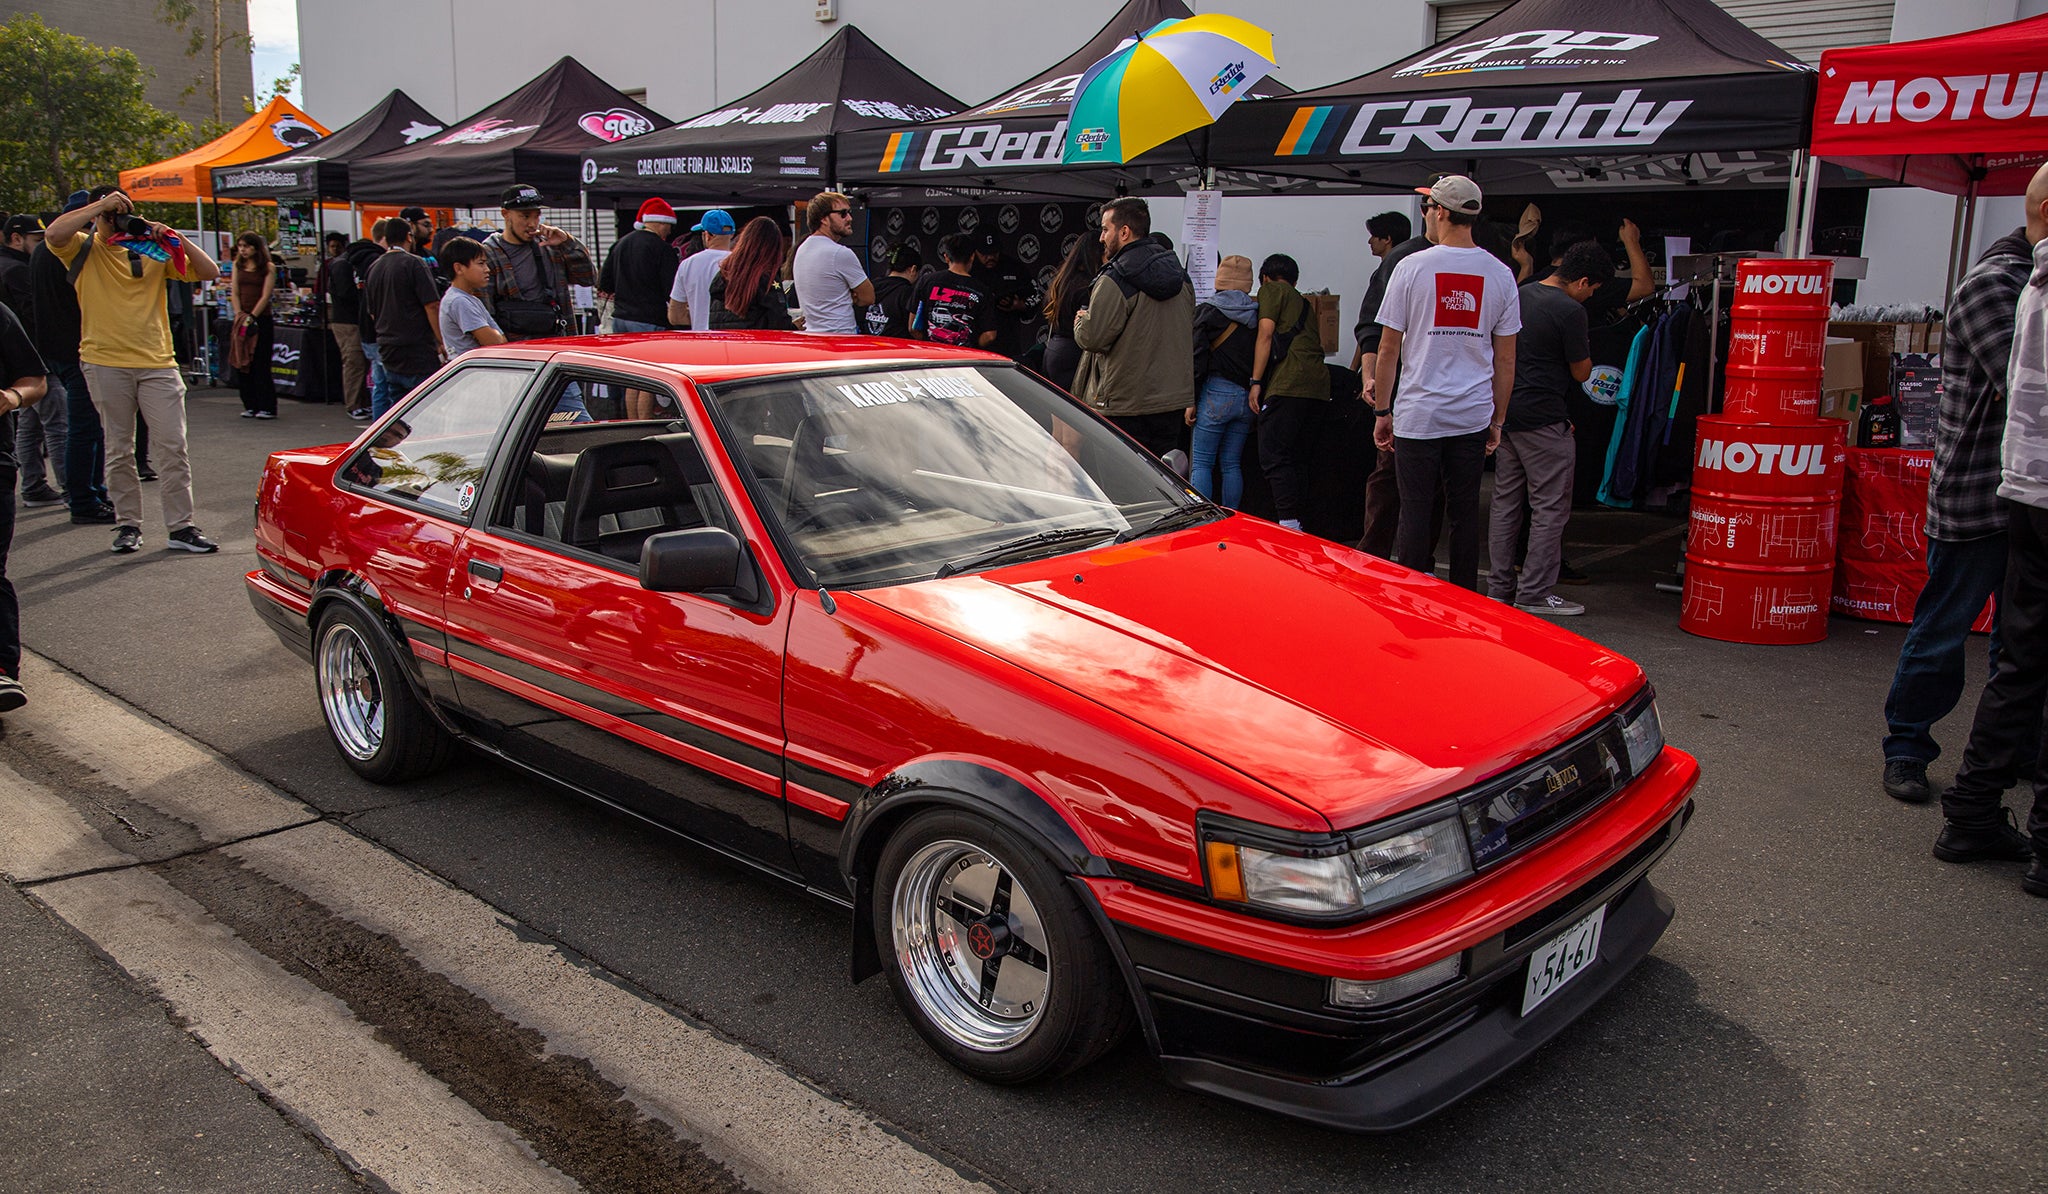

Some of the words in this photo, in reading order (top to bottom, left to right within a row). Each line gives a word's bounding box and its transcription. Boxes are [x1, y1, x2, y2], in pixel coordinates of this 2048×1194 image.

[1439, 59, 1527, 72] PERFORMANCE
[1209, 61, 1245, 96] GReddy
[1339, 89, 1694, 155] GReddy
[919, 119, 1067, 172] GRed
[1075, 131, 1110, 146] GReddy
[637, 158, 653, 175] CAR
[653, 157, 687, 175] CULTURE
[687, 157, 704, 174] FOR
[704, 157, 719, 174] ALL
[720, 156, 752, 175] SCALES
[986, 235, 993, 245] G
[1451, 290, 1465, 298] THE
[1742, 274, 1824, 295] MOTUL
[1441, 296, 1464, 304] NORTH
[1446, 303, 1463, 311] FACE
[1759, 334, 1767, 355] BLEND
[836, 381, 909, 408] KAIDO
[915, 375, 985, 400] HOUSE
[1697, 438, 1827, 476] MOTUL
[1726, 517, 1737, 549] BLEND
[1769, 604, 1818, 614] AUTHENTIC
[1833, 595, 1892, 612] SPECIALIST
[1541, 922, 1598, 996] 54-61
